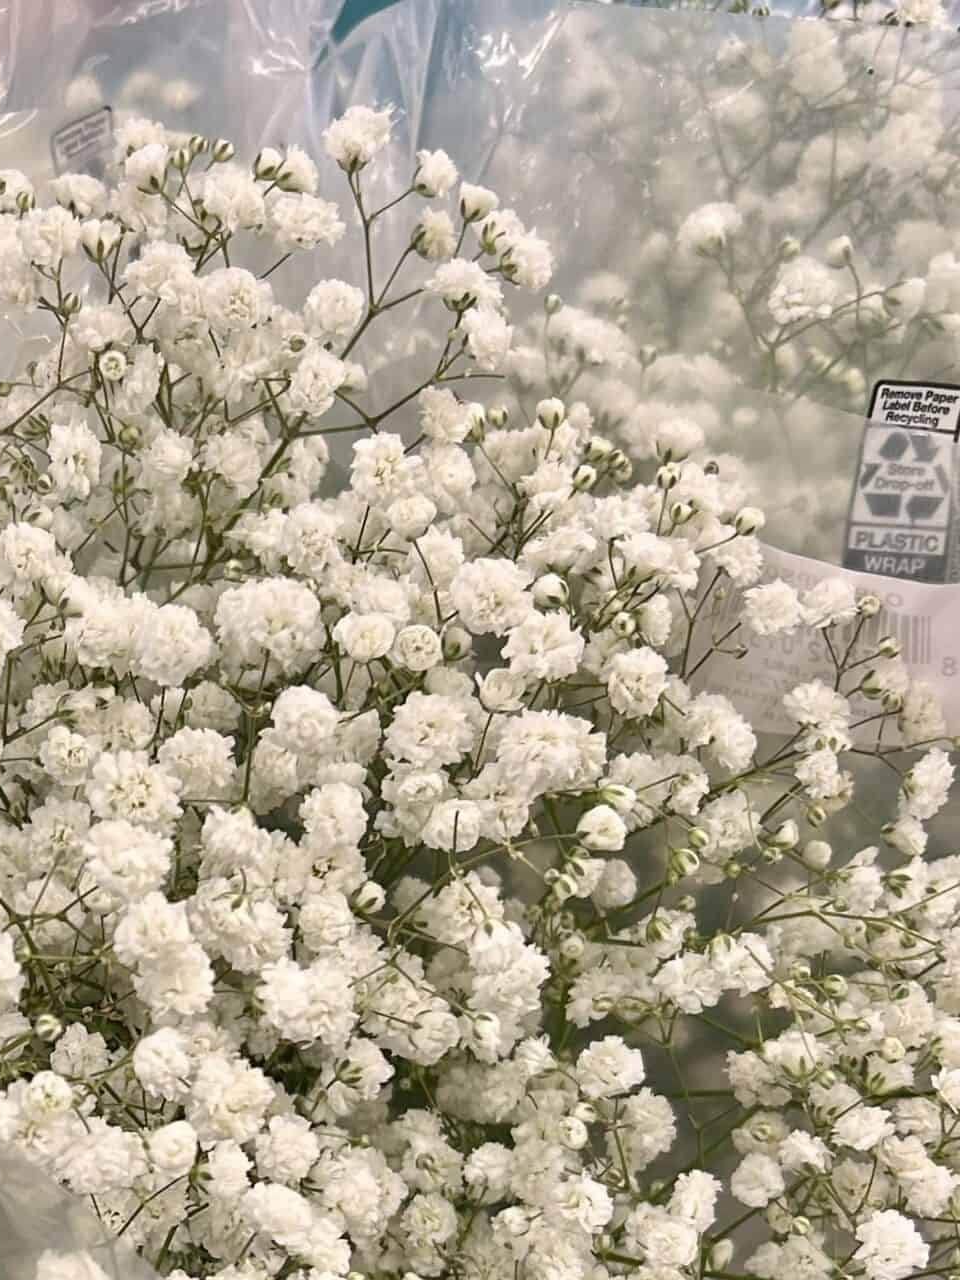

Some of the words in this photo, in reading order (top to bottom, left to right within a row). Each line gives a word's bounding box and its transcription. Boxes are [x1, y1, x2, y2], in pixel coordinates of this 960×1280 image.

[881, 388, 923, 400] Remove
[925, 390, 960, 404] Paper
[882, 400, 912, 411] Label
[912, 402, 951, 415] Before
[885, 412, 939, 427] Recycling
[856, 531, 939, 552] PLASTIC
[864, 555, 926, 575] WRAP
